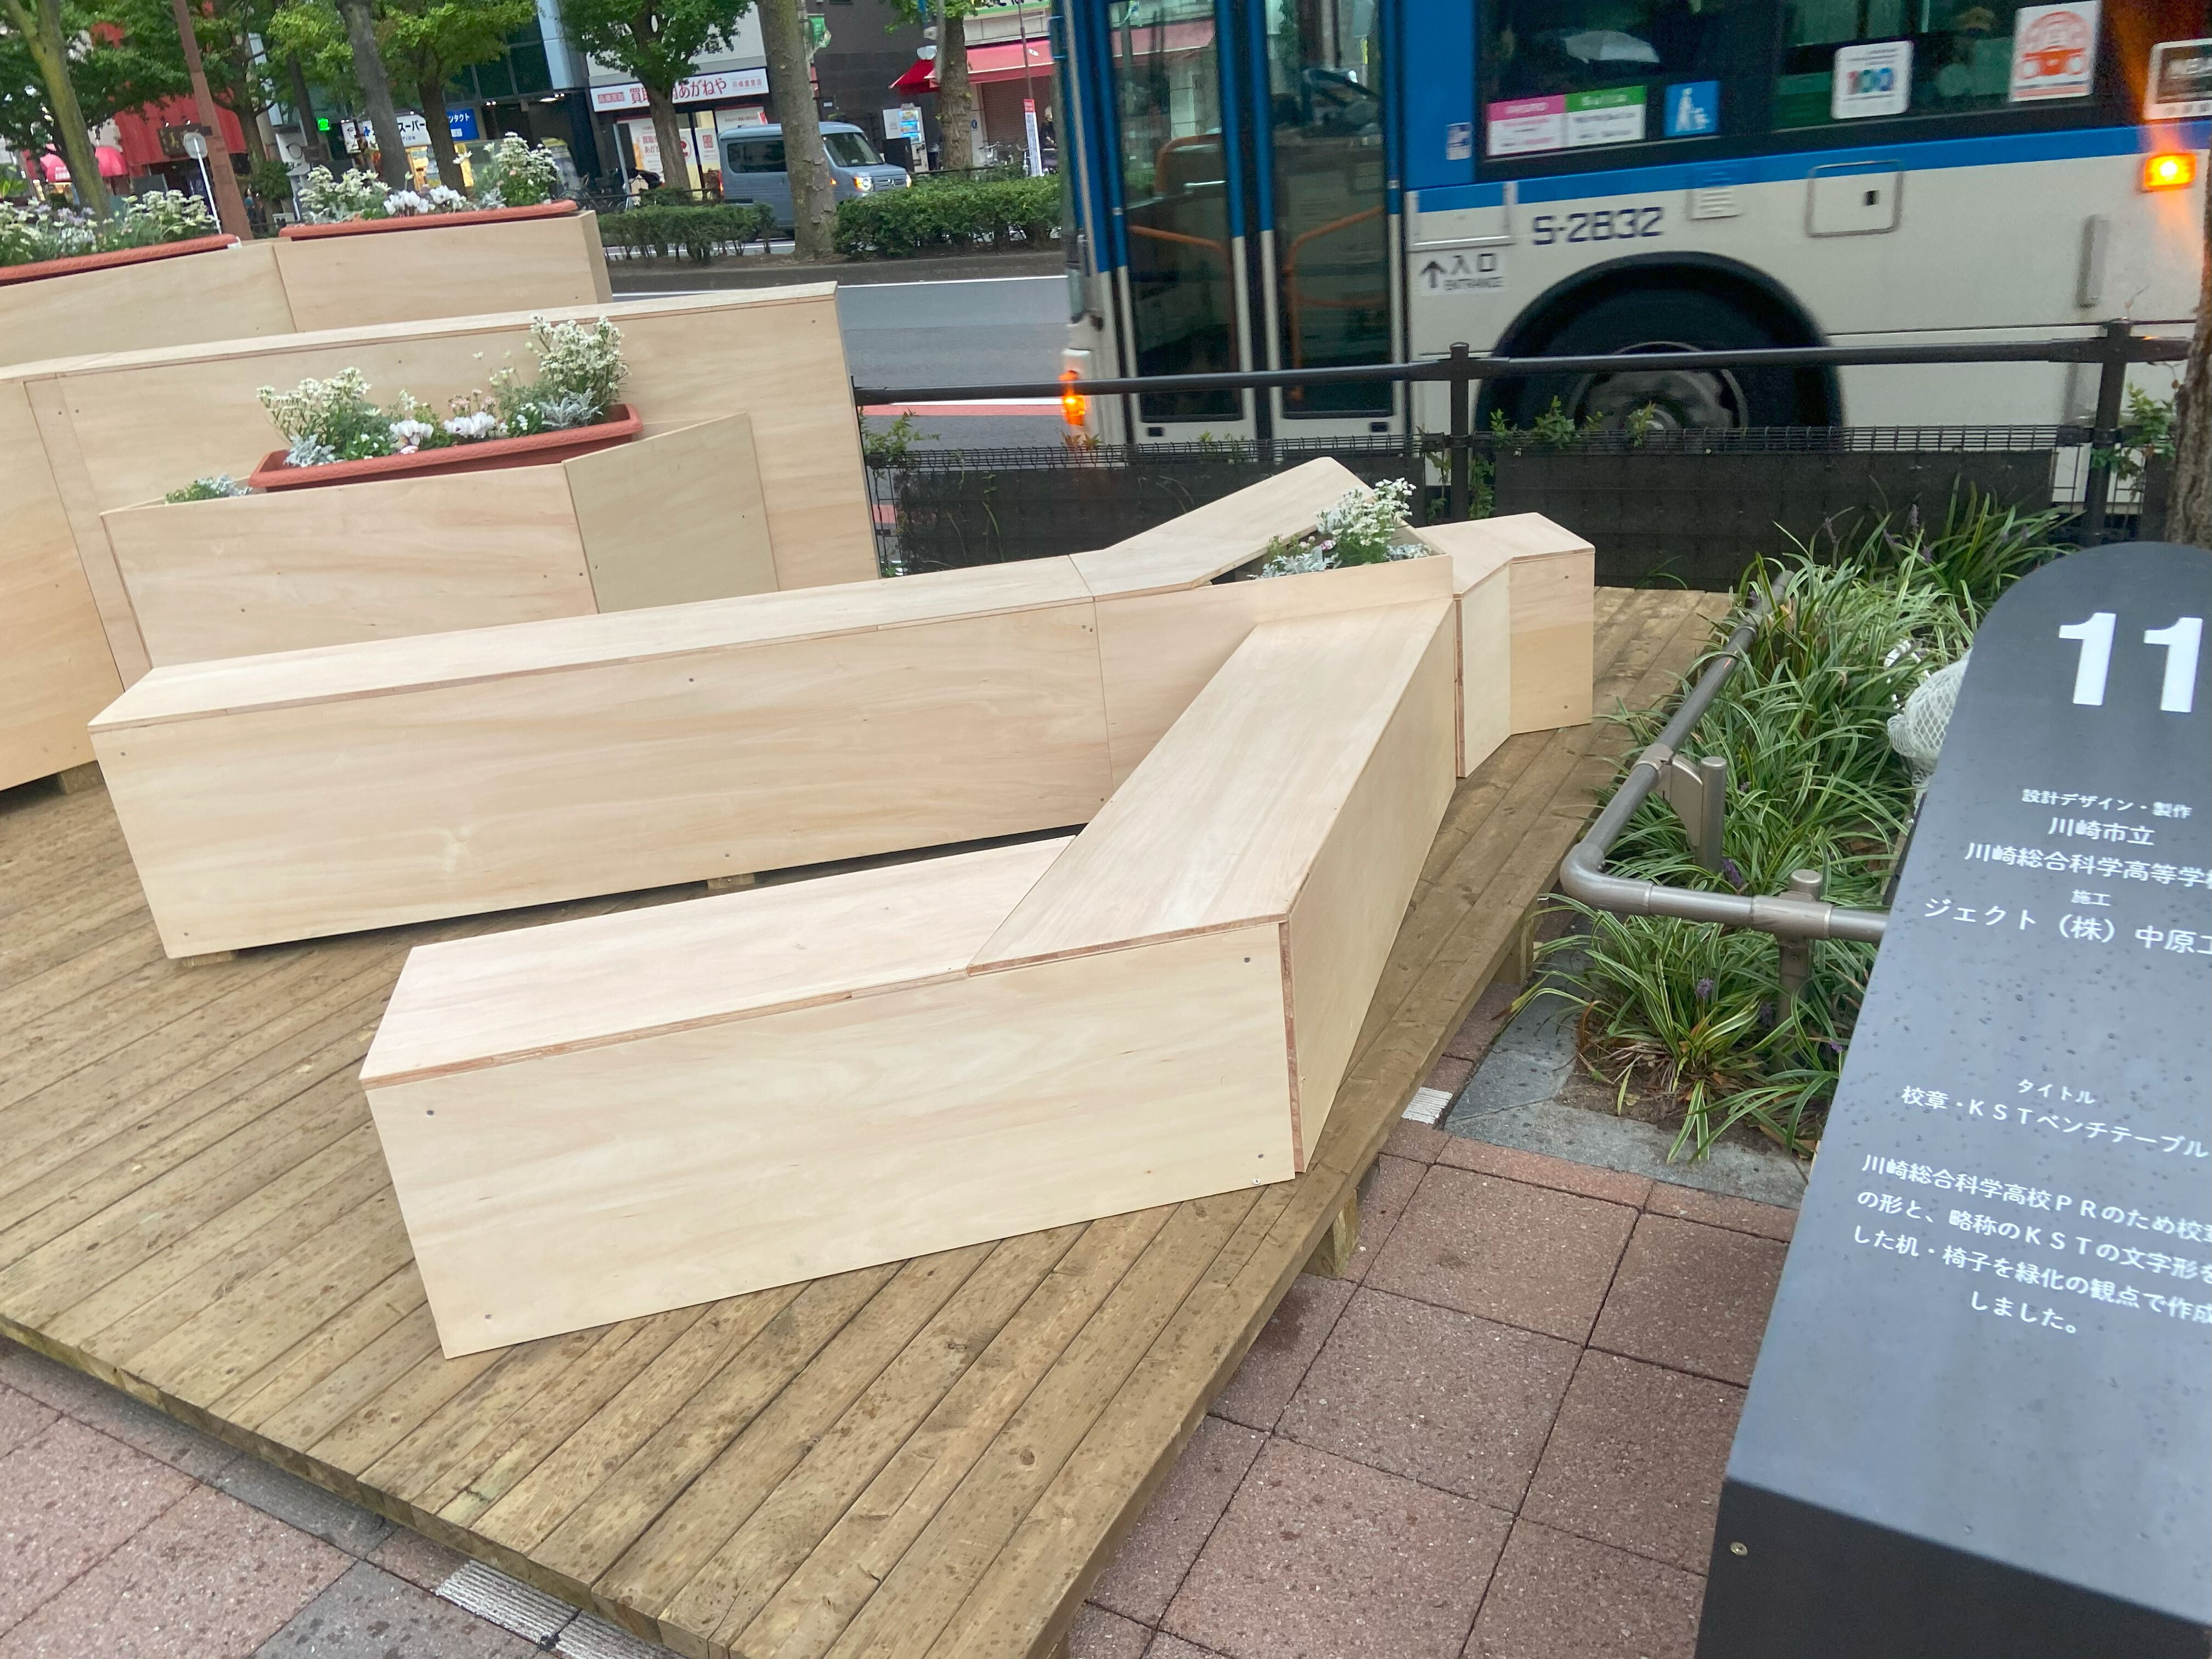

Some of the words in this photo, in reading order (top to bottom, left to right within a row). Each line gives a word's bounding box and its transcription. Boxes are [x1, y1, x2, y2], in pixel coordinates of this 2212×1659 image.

[1533, 206, 1664, 245] S-2832
[1449, 253, 1498, 274] 入口
[2058, 612, 2203, 714] 11
[2022, 788, 2193, 820] 設計デザイン・製作
[2047, 817, 2155, 847] 川崎市立
[2070, 889, 2112, 907] 施工
[2018, 1079, 2097, 1105] タイトル
[1971, 1290, 2077, 1335] しました。
